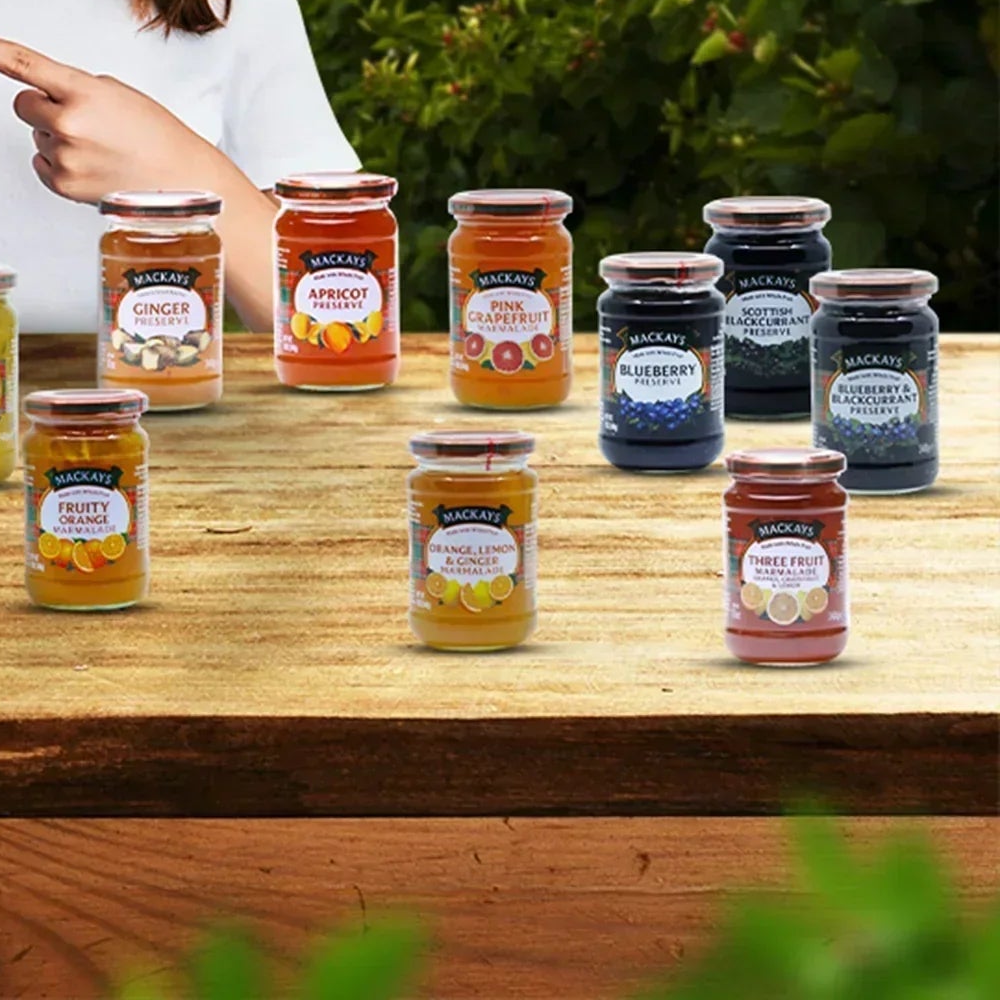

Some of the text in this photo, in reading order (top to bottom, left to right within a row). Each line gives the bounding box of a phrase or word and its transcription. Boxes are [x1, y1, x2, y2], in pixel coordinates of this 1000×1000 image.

[310, 253, 366, 267] MACKAYS
[133, 271, 190, 285] MACKAYS
[479, 272, 536, 287] MACKAYS
[740, 275, 796, 289] MACKAYS
[308, 287, 368, 300] APRICOT
[132, 302, 190, 316] GINGER
[313, 301, 363, 310] PRESERVE
[490, 300, 524, 312] PINK
[741, 306, 793, 317] SCOTTISH
[134, 316, 189, 326] PRESERVE
[468, 311, 549, 325] GRAPEFRUIT
[629, 331, 686, 345] MACKAYS
[743, 327, 791, 336] PRESERVE
[844, 353, 903, 369] MACKAYS
[620, 364, 697, 377] BLUEBERRY
[838, 383, 911, 395] BLUEBERRY &
[832, 392, 917, 405] BLACKCURRANT
[850, 406, 899, 415] PRESERVE
[54, 470, 113, 486] MACKAYS
[58, 501, 110, 514] FRUITY
[58, 515, 110, 525] ORANGE
[443, 508, 501, 523] MACKAYS
[758, 522, 815, 537] MACKAYS
[429, 543, 516, 556] ORANGE, LEMON
[445, 556, 499, 566] & GINGER
[748, 555, 825, 567] THREE FRUIT
[440, 566, 504, 575] MARMALADE
[755, 567, 816, 576] MARMALADE
